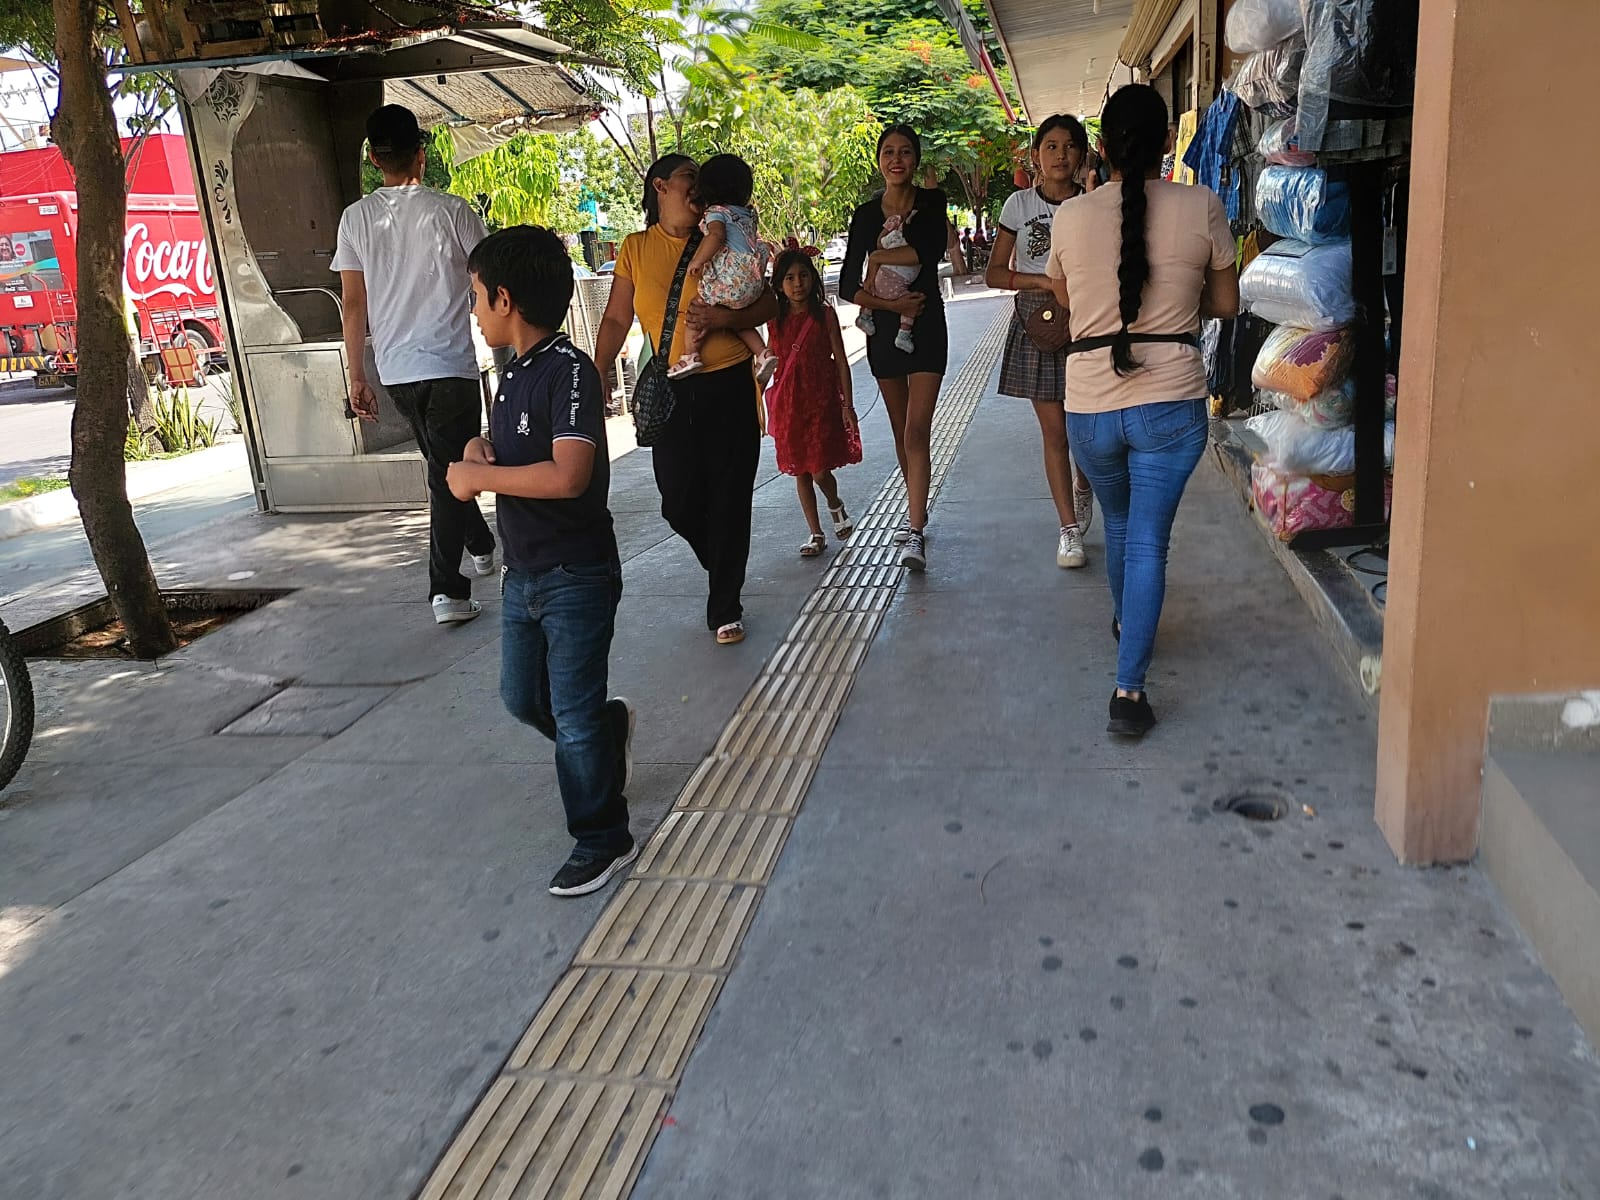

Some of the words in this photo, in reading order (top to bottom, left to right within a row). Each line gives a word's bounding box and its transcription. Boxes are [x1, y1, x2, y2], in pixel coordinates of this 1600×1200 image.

[122, 222, 215, 301] Coca-C
[571, 363, 580, 389] Psycho
[569, 402, 580, 426] Bunny
